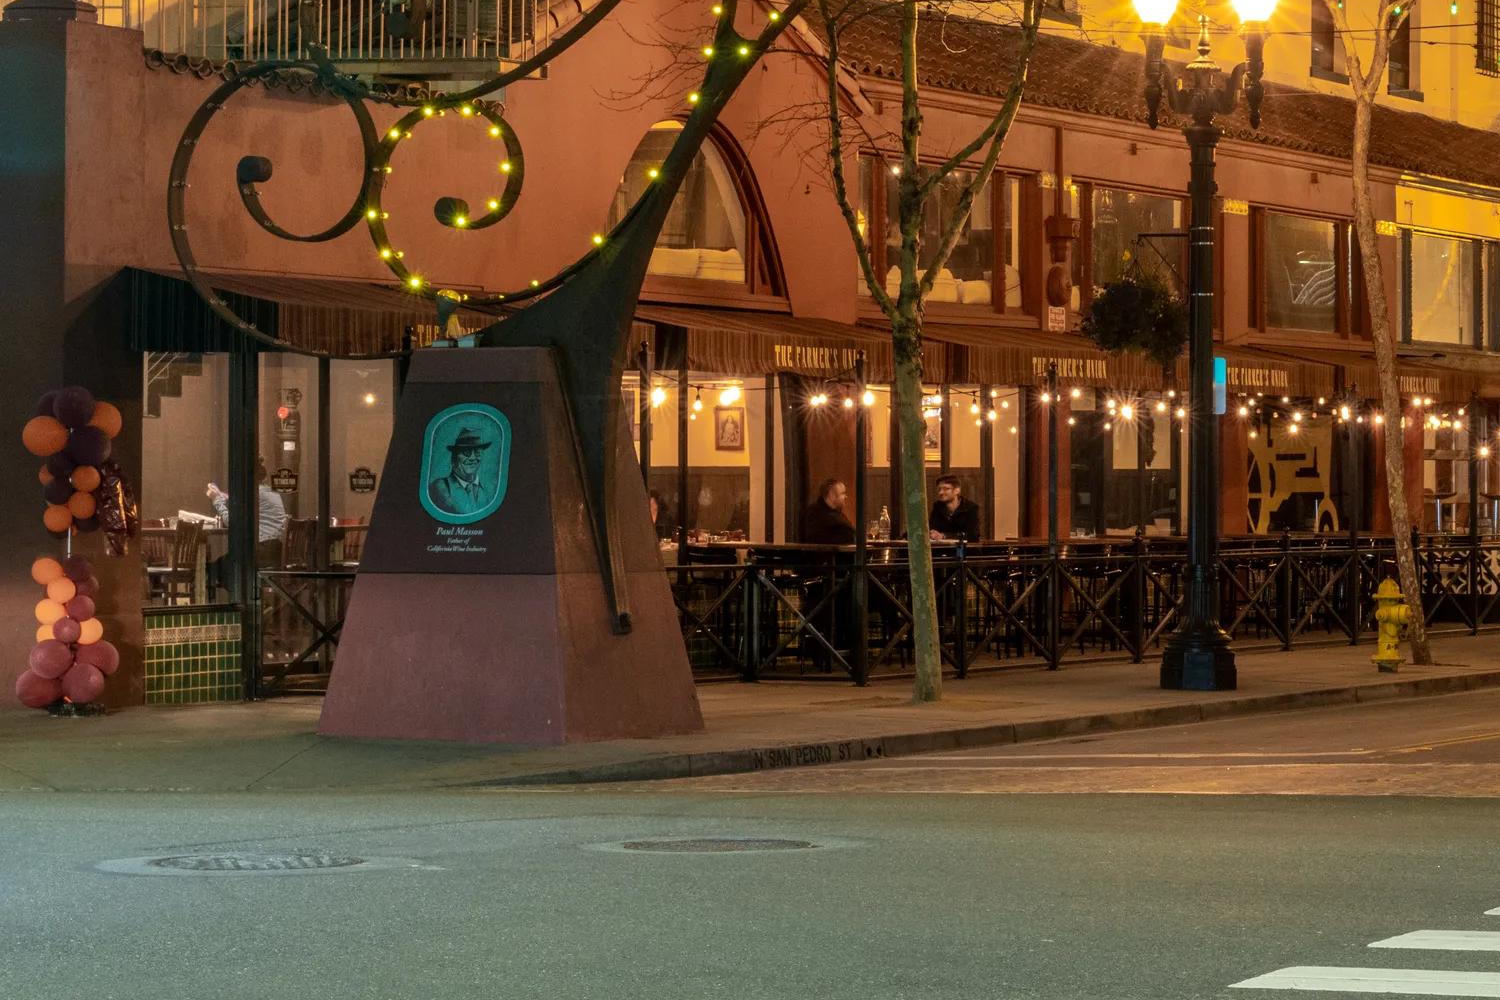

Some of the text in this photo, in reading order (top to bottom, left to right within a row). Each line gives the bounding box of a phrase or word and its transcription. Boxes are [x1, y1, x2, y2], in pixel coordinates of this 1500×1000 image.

[775, 344, 793, 367] THE
[796, 345, 839, 369] FARMER'S
[436, 526, 455, 536] Paul
